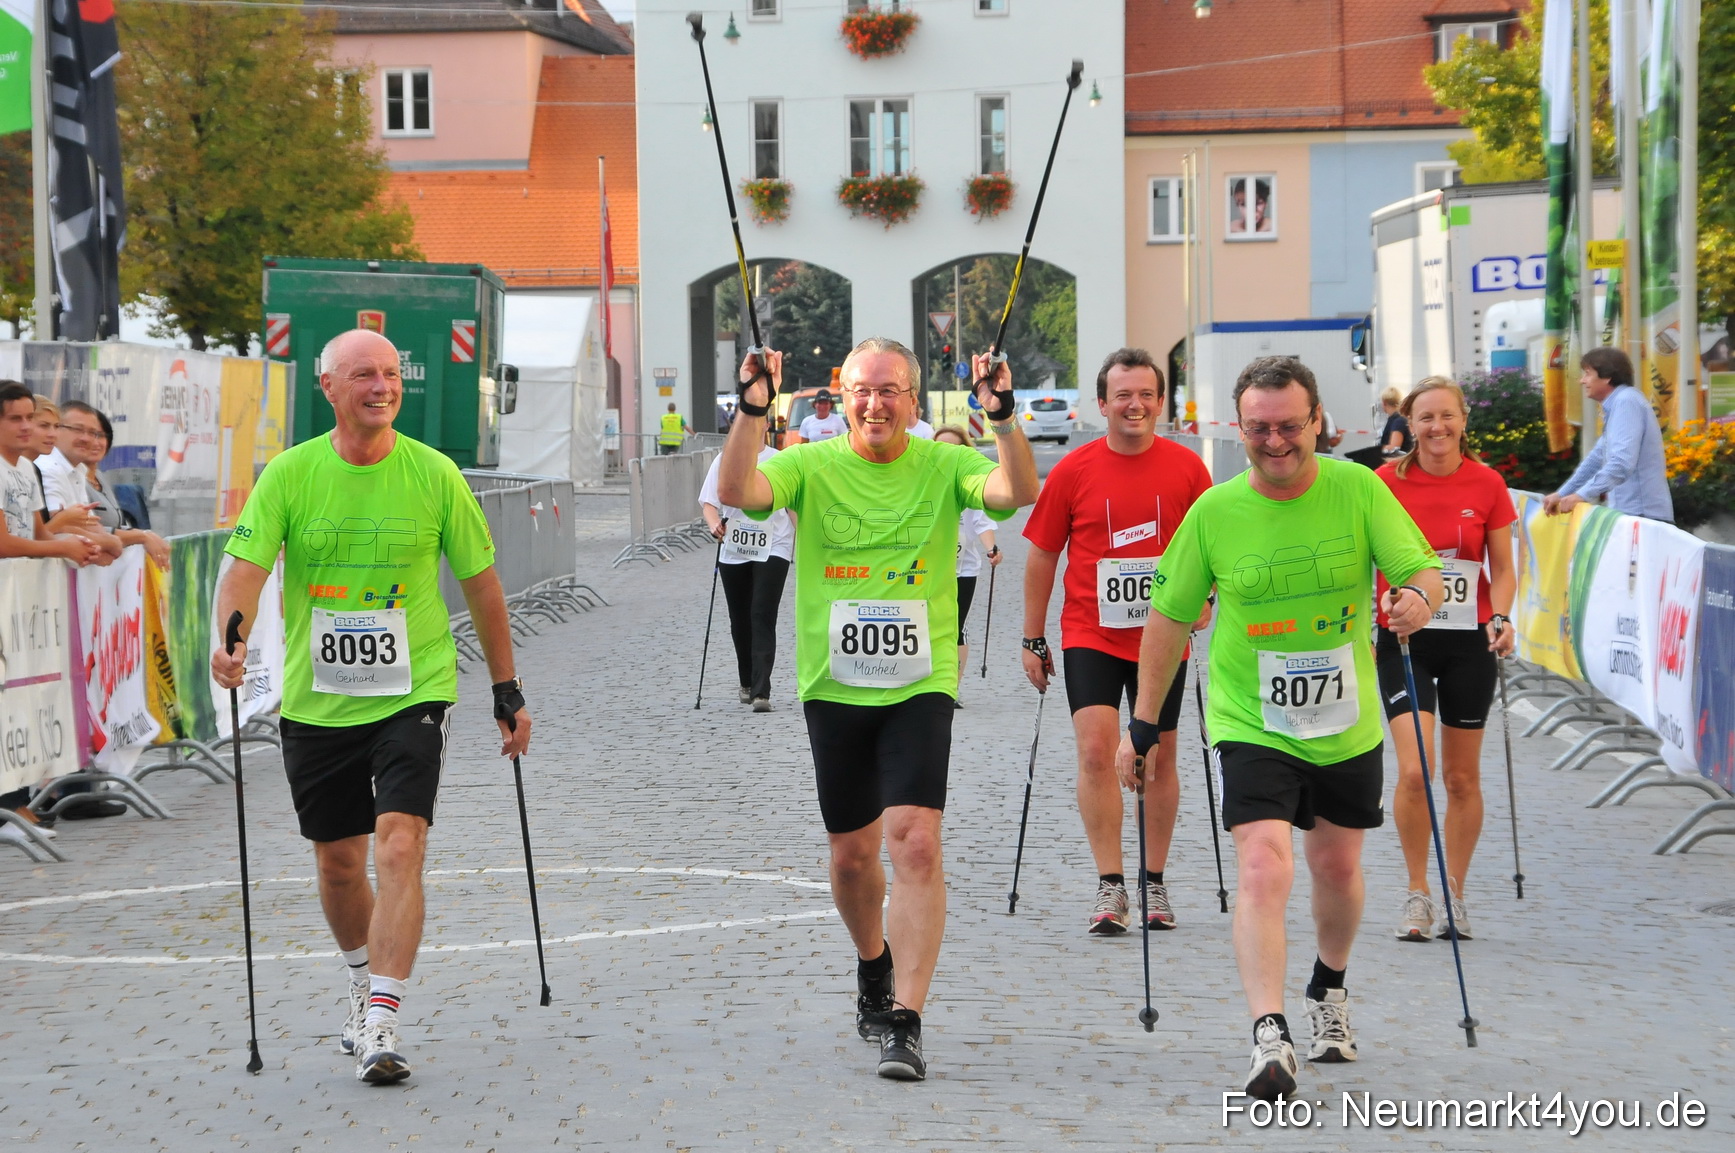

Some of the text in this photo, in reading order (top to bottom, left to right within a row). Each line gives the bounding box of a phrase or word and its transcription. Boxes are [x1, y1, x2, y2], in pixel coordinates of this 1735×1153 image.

[732, 529, 767, 547] 8018
[1125, 528, 1145, 540] DEHN
[737, 547, 759, 556] Marina
[826, 566, 870, 579] MERZ
[1120, 562, 1154, 572] BOCK
[1106, 576, 1153, 603] 806
[364, 592, 408, 601] Bretschneider
[858, 606, 901, 616] BOCK
[1127, 606, 1149, 619] Karl
[335, 616, 376, 627] BOCK
[1247, 619, 1297, 637] MERZ
[841, 623, 919, 656] 8095
[321, 632, 397, 666] 8093
[853, 659, 899, 677] Manfred
[1286, 656, 1330, 669] BOCK
[335, 670, 379, 684] Gerhard
[1271, 670, 1344, 707] 8071
[1285, 711, 1320, 727] Helmut
